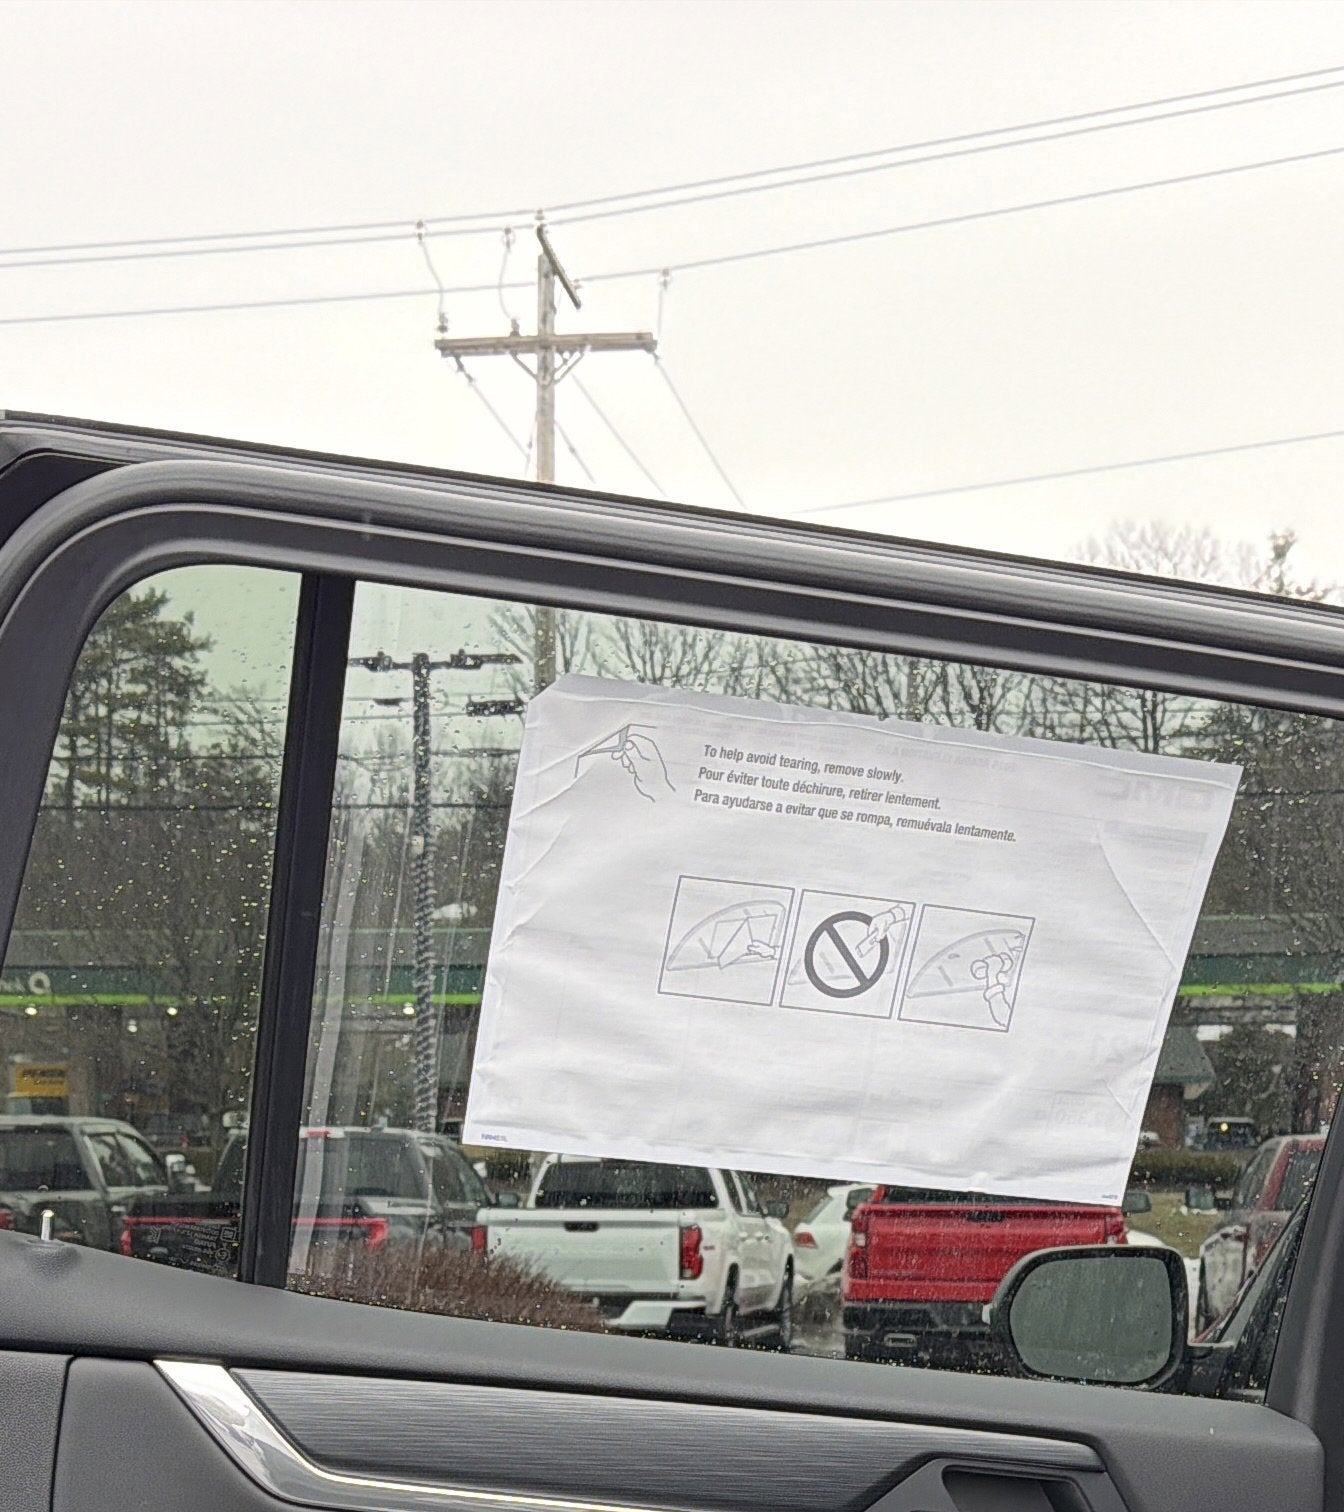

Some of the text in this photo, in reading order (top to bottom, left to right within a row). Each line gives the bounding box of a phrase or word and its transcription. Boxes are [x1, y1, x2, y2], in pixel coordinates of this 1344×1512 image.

[704, 744, 904, 784] To help avoid tearing, remove slowly.
[698, 766, 942, 810] Pour éviter toute déchirure, retirer lentement.
[693, 789, 1017, 842] Para ayudarse a evitar que se rompa, remuévala lentamente.
